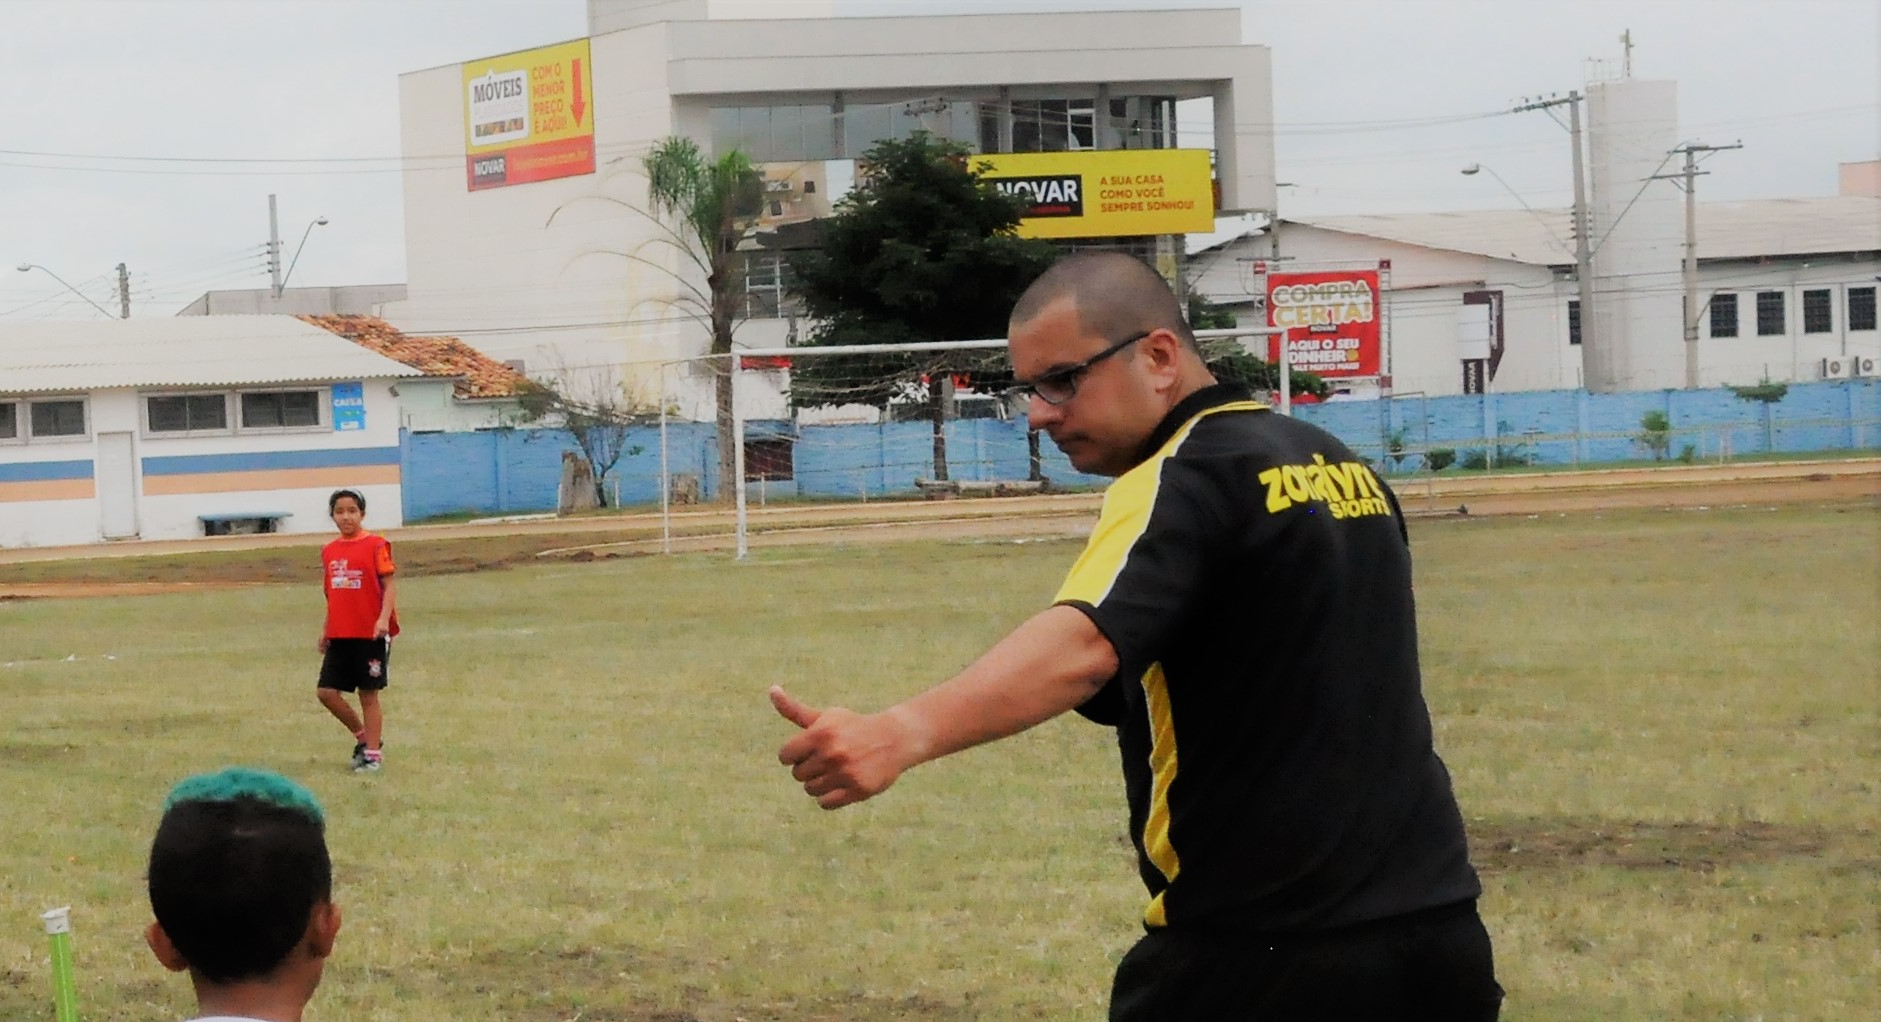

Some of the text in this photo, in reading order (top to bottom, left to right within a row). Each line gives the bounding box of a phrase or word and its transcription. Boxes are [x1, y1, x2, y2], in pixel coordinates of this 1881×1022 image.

[532, 65, 552, 80] COM
[473, 76, 522, 103] MÓVEIS
[533, 80, 565, 98] MENOR
[474, 158, 505, 176] NOVAR
[1100, 175, 1164, 185] A SUA CASA
[996, 179, 1078, 203] NOVAR
[1100, 189, 1131, 199] COMO
[1101, 202, 1144, 213] SEMPRE
[1273, 281, 1371, 303] COMPRA
[1274, 302, 1372, 328] CERTA!
[1288, 338, 1359, 352] AQUI O SEU
